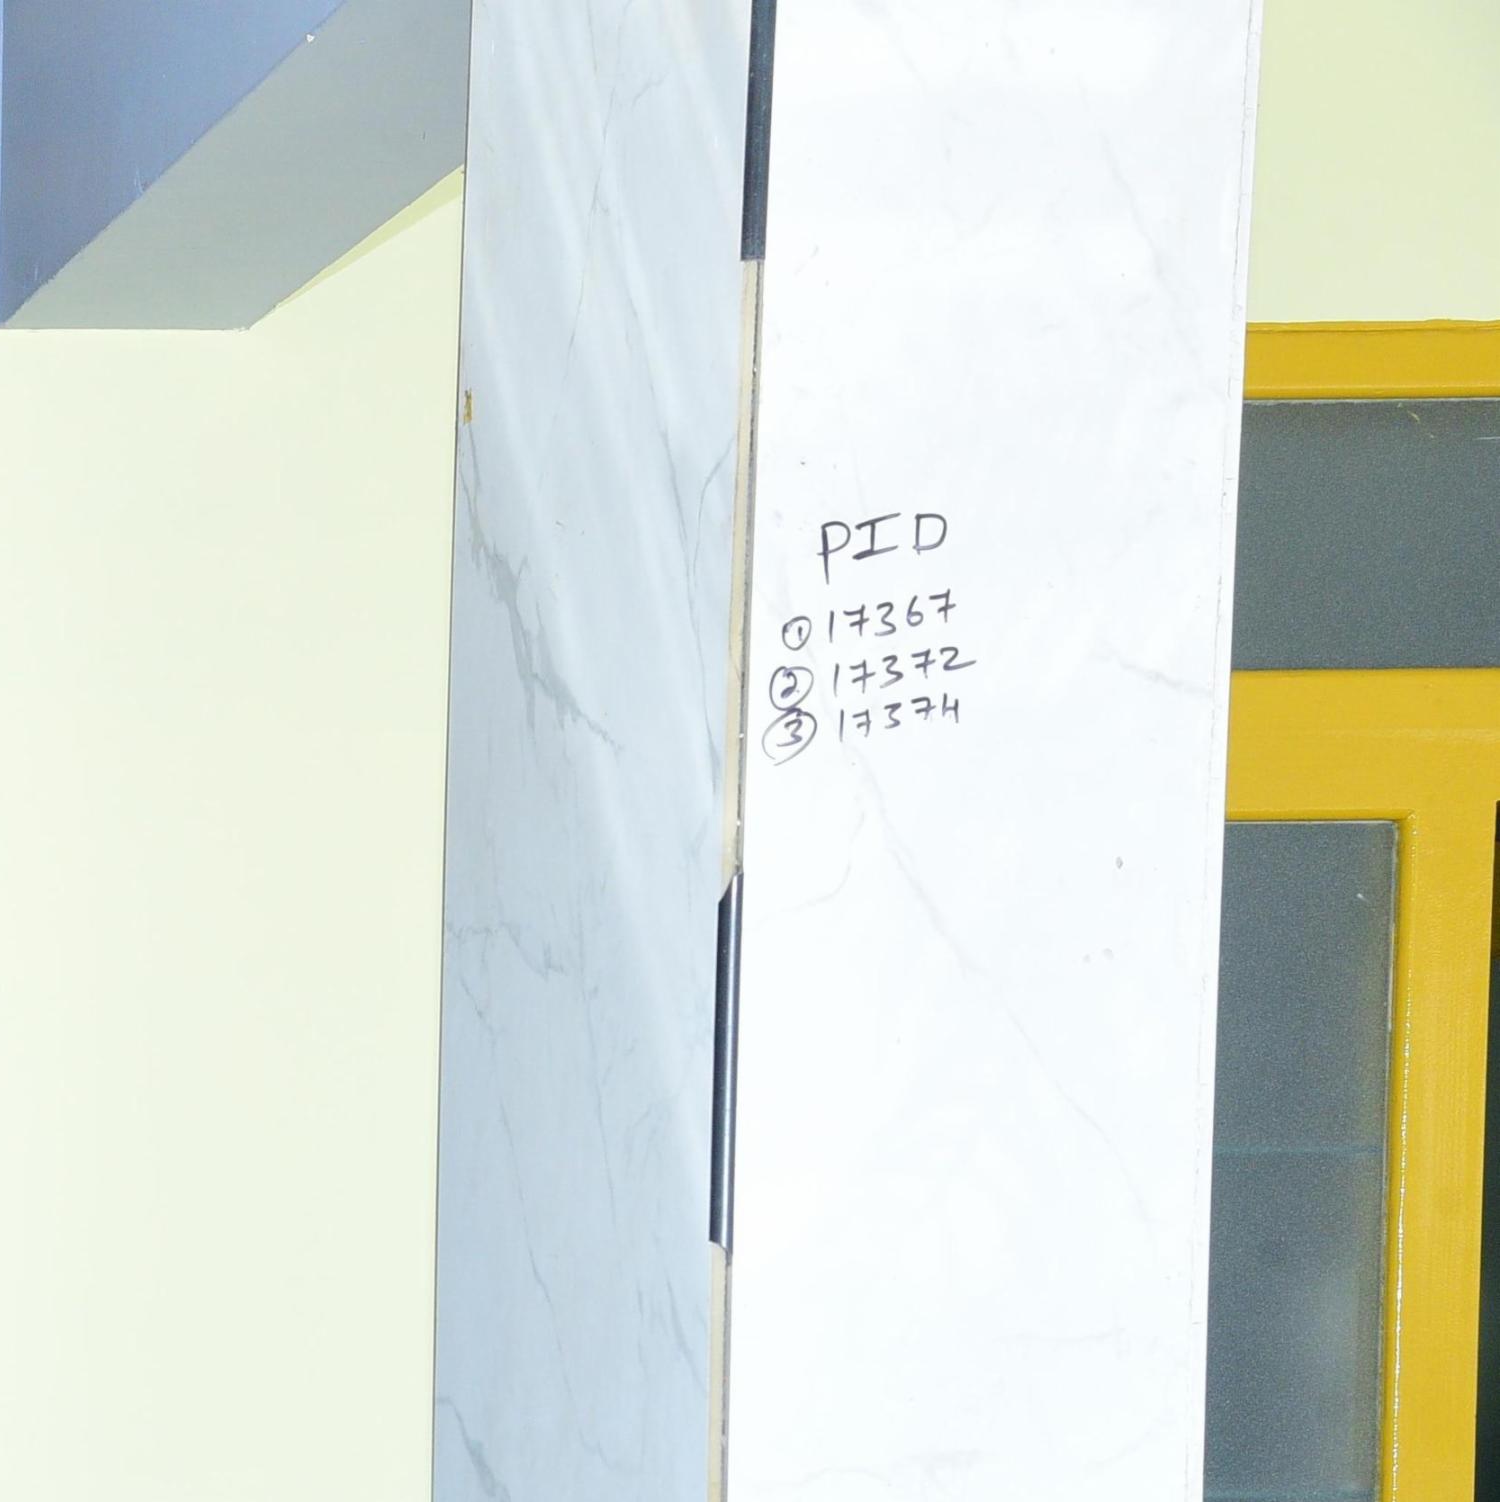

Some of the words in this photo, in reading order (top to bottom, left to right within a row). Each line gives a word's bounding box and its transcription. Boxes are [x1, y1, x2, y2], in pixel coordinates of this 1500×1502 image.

[817, 512, 948, 584] PID
[827, 589, 957, 642] 17367
[833, 646, 977, 698] 17372
[838, 694, 961, 741] 17374
